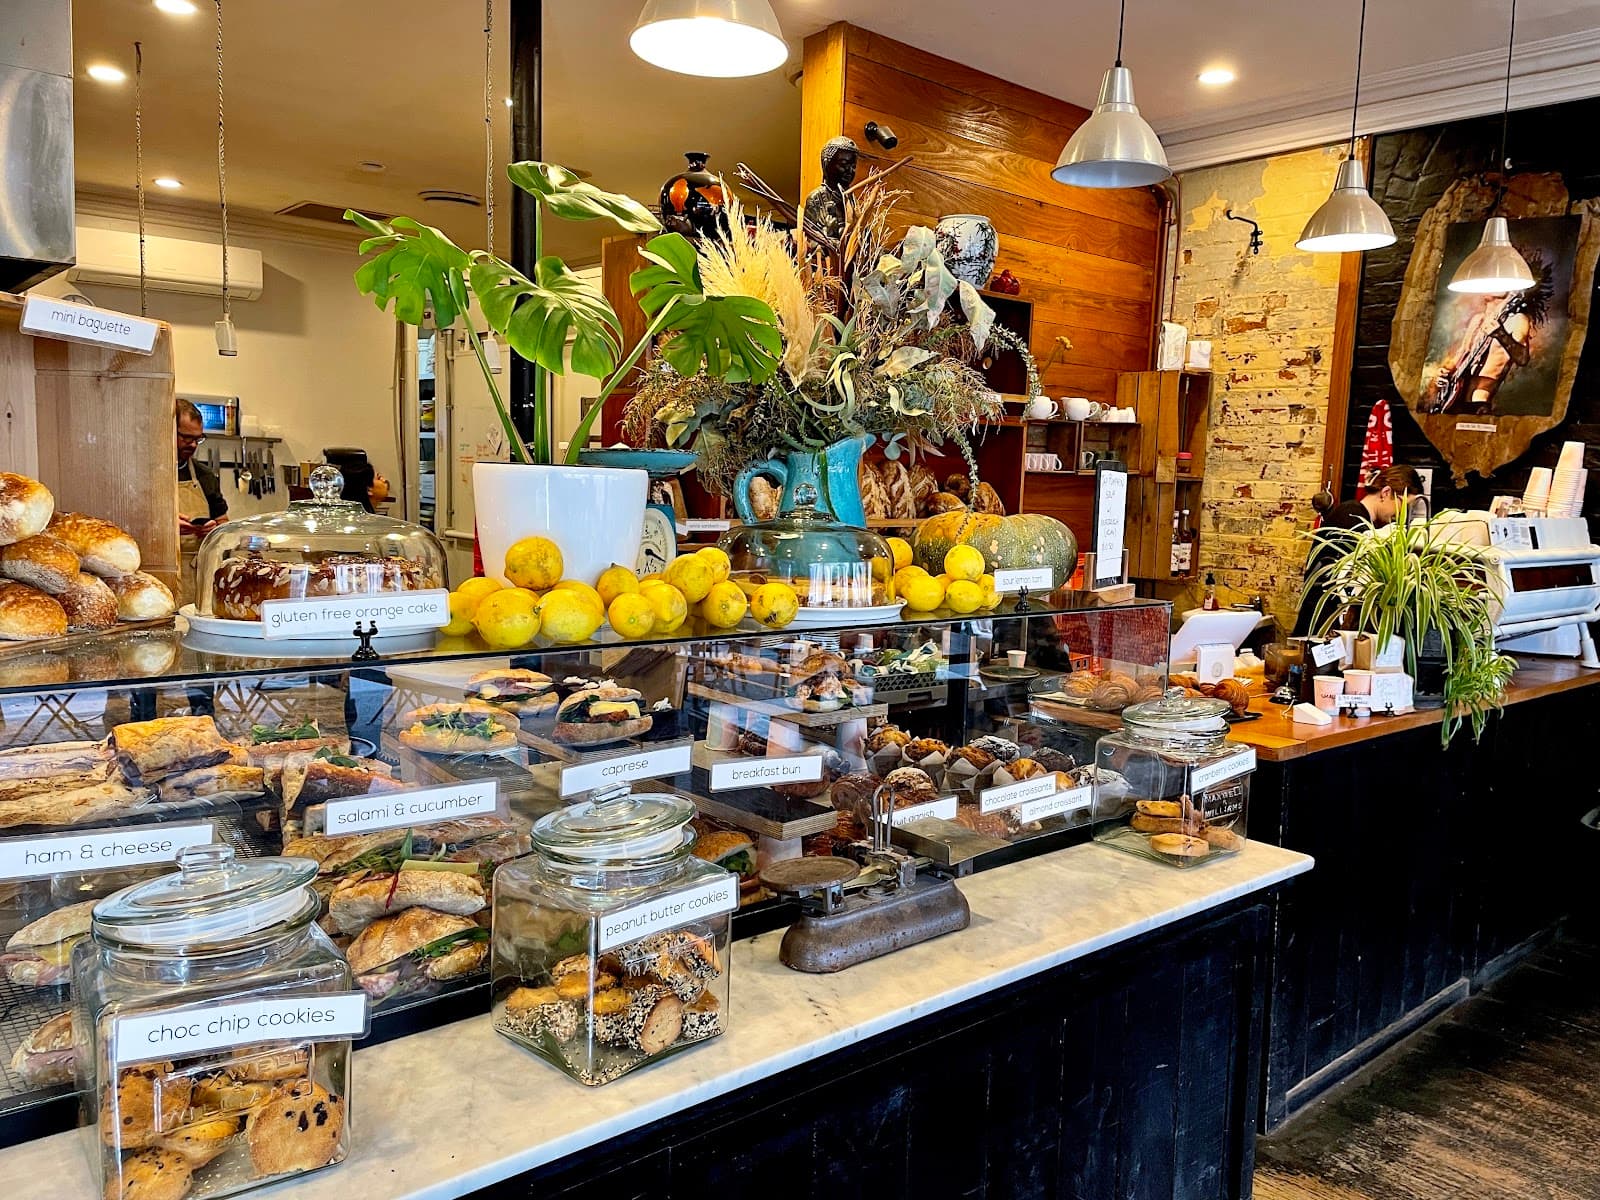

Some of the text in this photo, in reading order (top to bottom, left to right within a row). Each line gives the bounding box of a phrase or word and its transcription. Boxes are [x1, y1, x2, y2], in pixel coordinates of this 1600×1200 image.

[51, 310, 131, 335] mini baguette
[271, 602, 438, 627] gluten free orange cake
[601, 759, 649, 776] caprese
[732, 764, 801, 780] breakfast bun
[1198, 757, 1249, 782] cranberry cookies
[984, 783, 1053, 806] chocolate croissants
[1029, 794, 1083, 816] almond croissant
[338, 794, 484, 825] salami & cucumber
[1204, 802, 1242, 819] WILLIAMS
[25, 840, 172, 865] ham & cheese
[606, 890, 729, 940] peanut butter cookies
[147, 1007, 335, 1043] choc chip cookies
